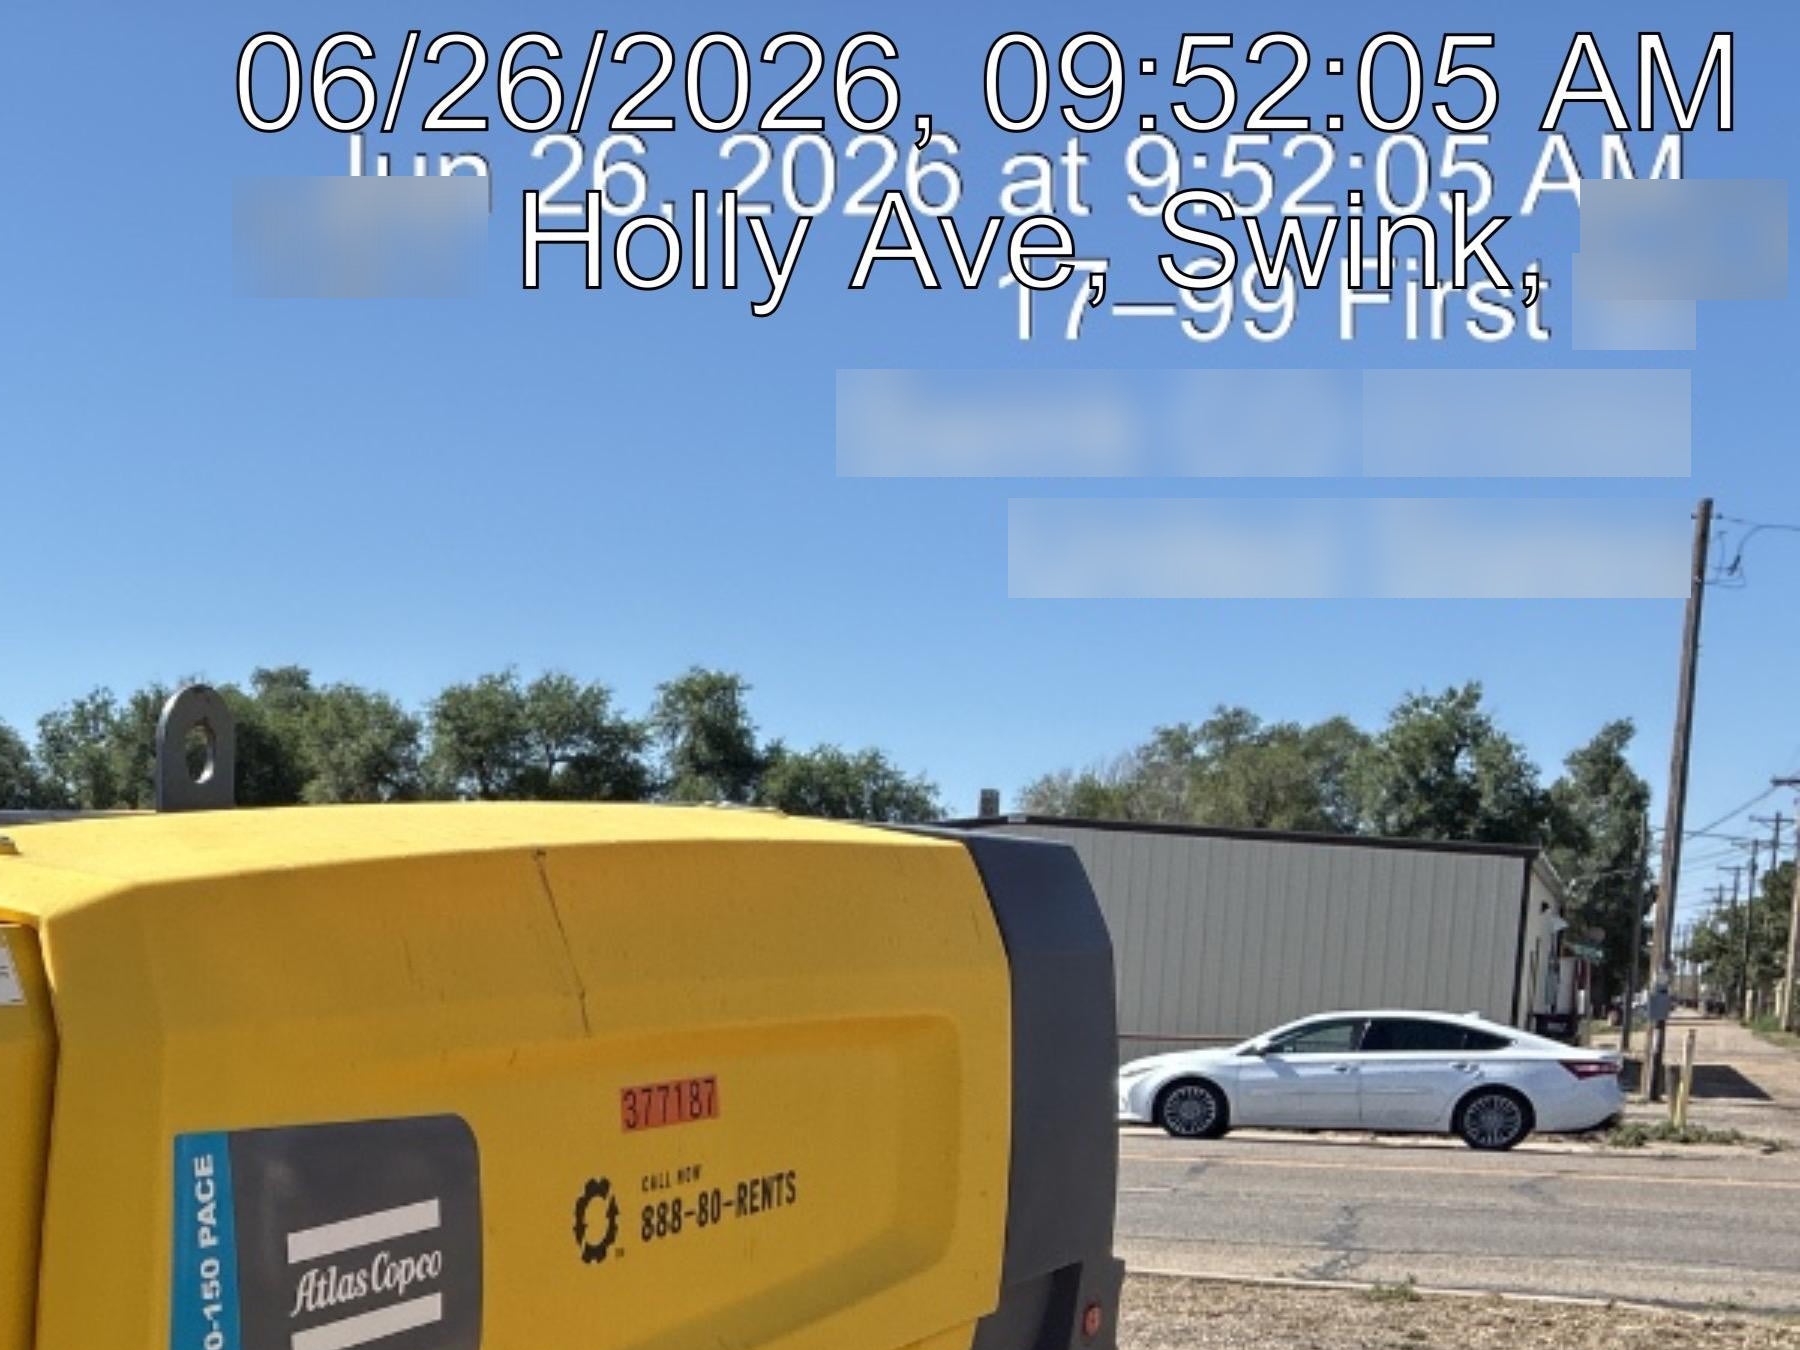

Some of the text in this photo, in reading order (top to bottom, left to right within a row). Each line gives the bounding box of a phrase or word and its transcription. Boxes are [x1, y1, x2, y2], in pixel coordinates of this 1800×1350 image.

[623, 1078, 715, 1130] 377187
[193, 1153, 218, 1249] PACE
[641, 1164, 703, 1193] CALL NOW
[641, 1169, 797, 1243] 888-80-RENTS
[289, 1250, 443, 1319] Atlas Copco
